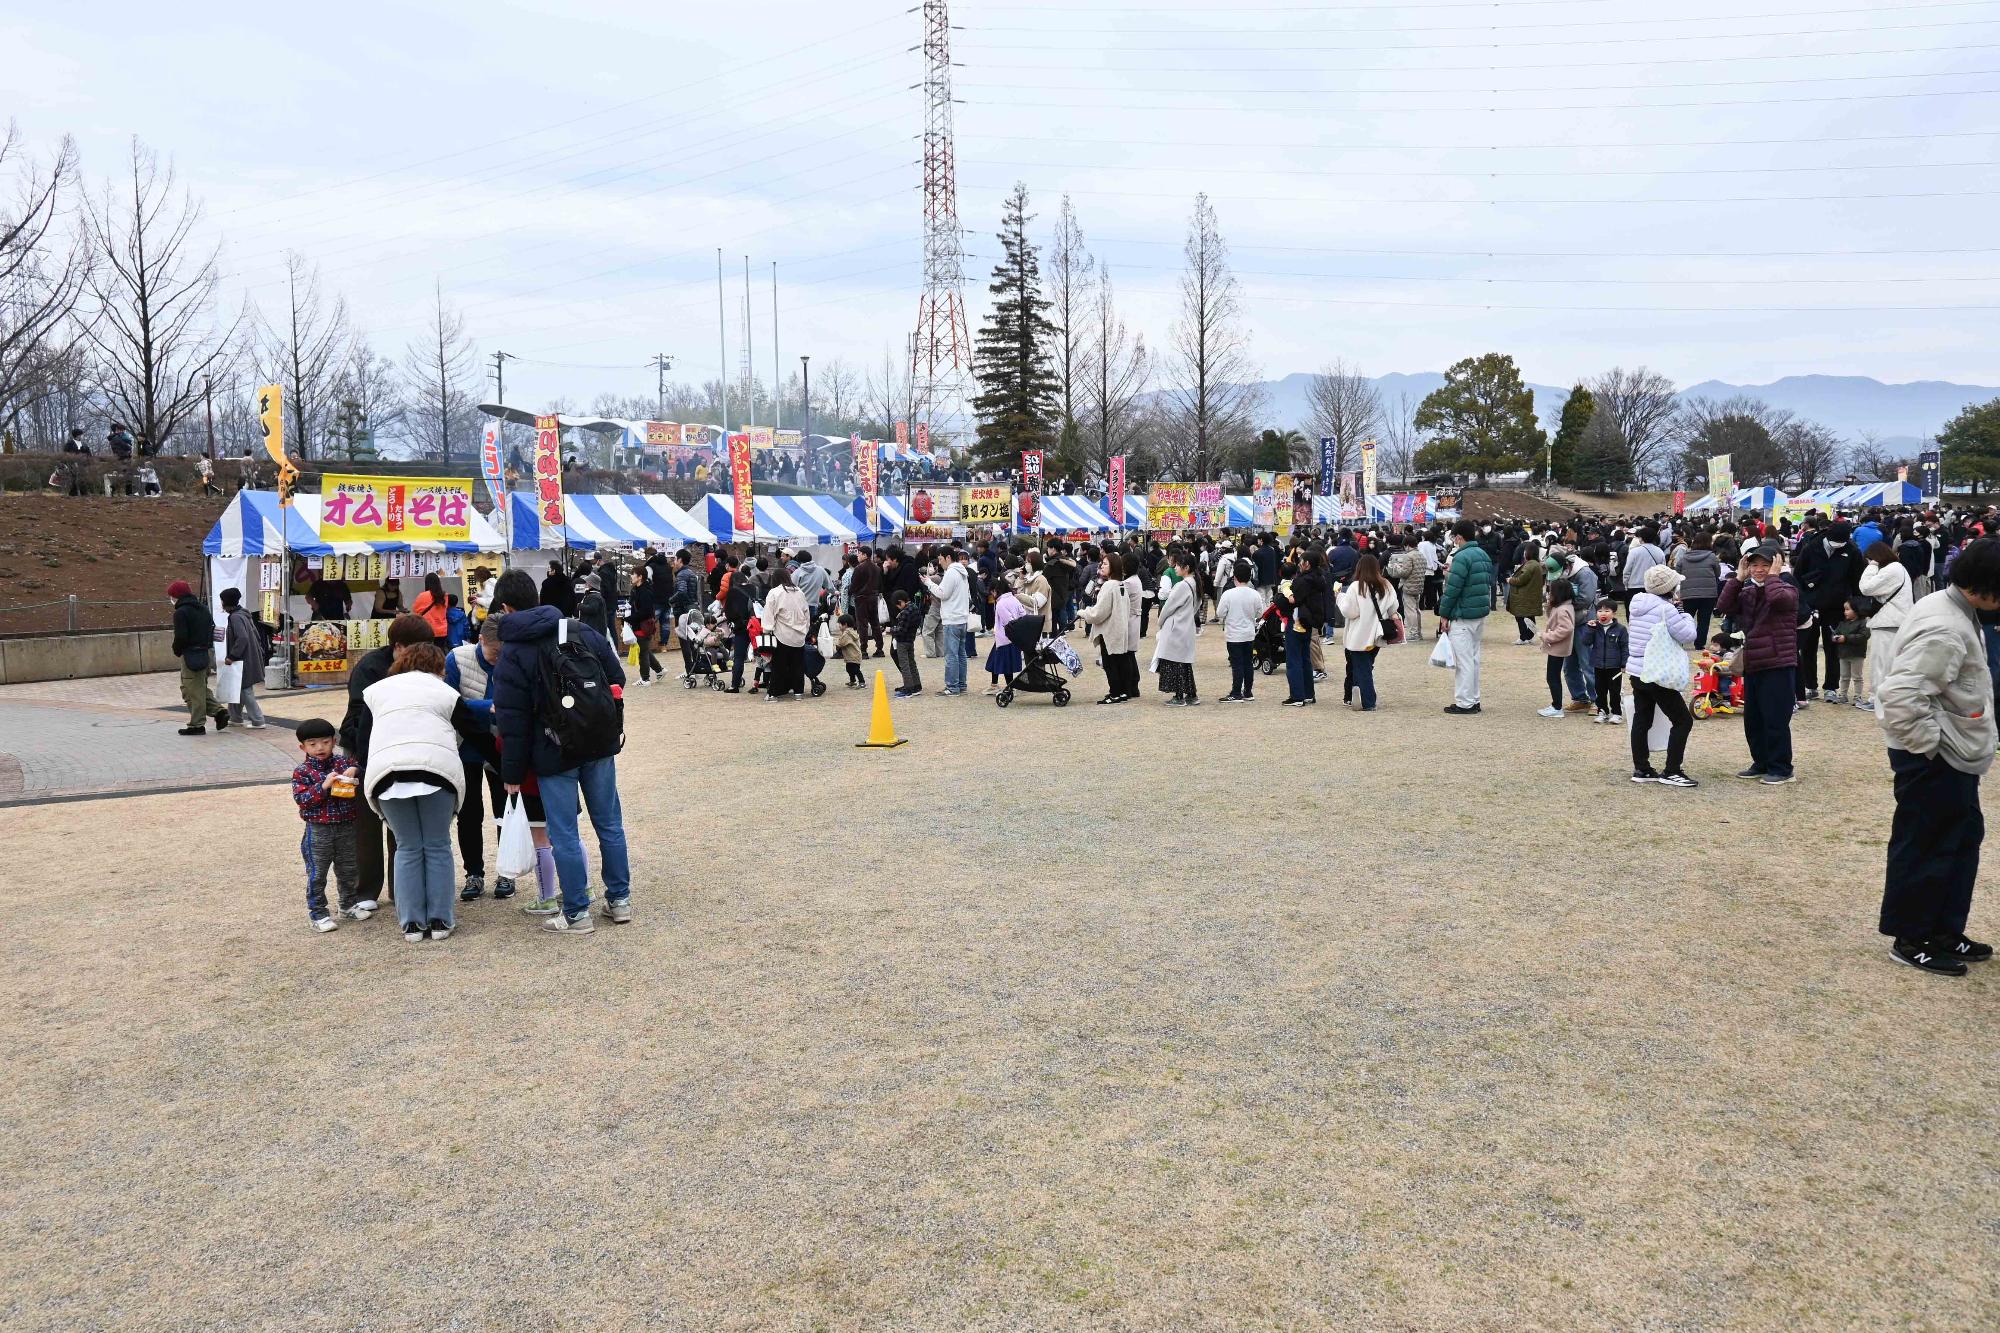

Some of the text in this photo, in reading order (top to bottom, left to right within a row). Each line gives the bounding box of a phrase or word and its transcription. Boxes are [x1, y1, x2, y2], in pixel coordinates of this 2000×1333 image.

[337, 483, 373, 493] 鉄板焼き
[416, 486, 462, 494] ソース焼きそば
[971, 489, 1000, 500] 炭火焼き
[323, 492, 383, 526] オム
[408, 493, 469, 527] そば
[1162, 512, 1184, 528] ポテト
[353, 621, 361, 648] オムそば
[373, 621, 381, 648] オムそば
[303, 660, 343, 671] オムそば
